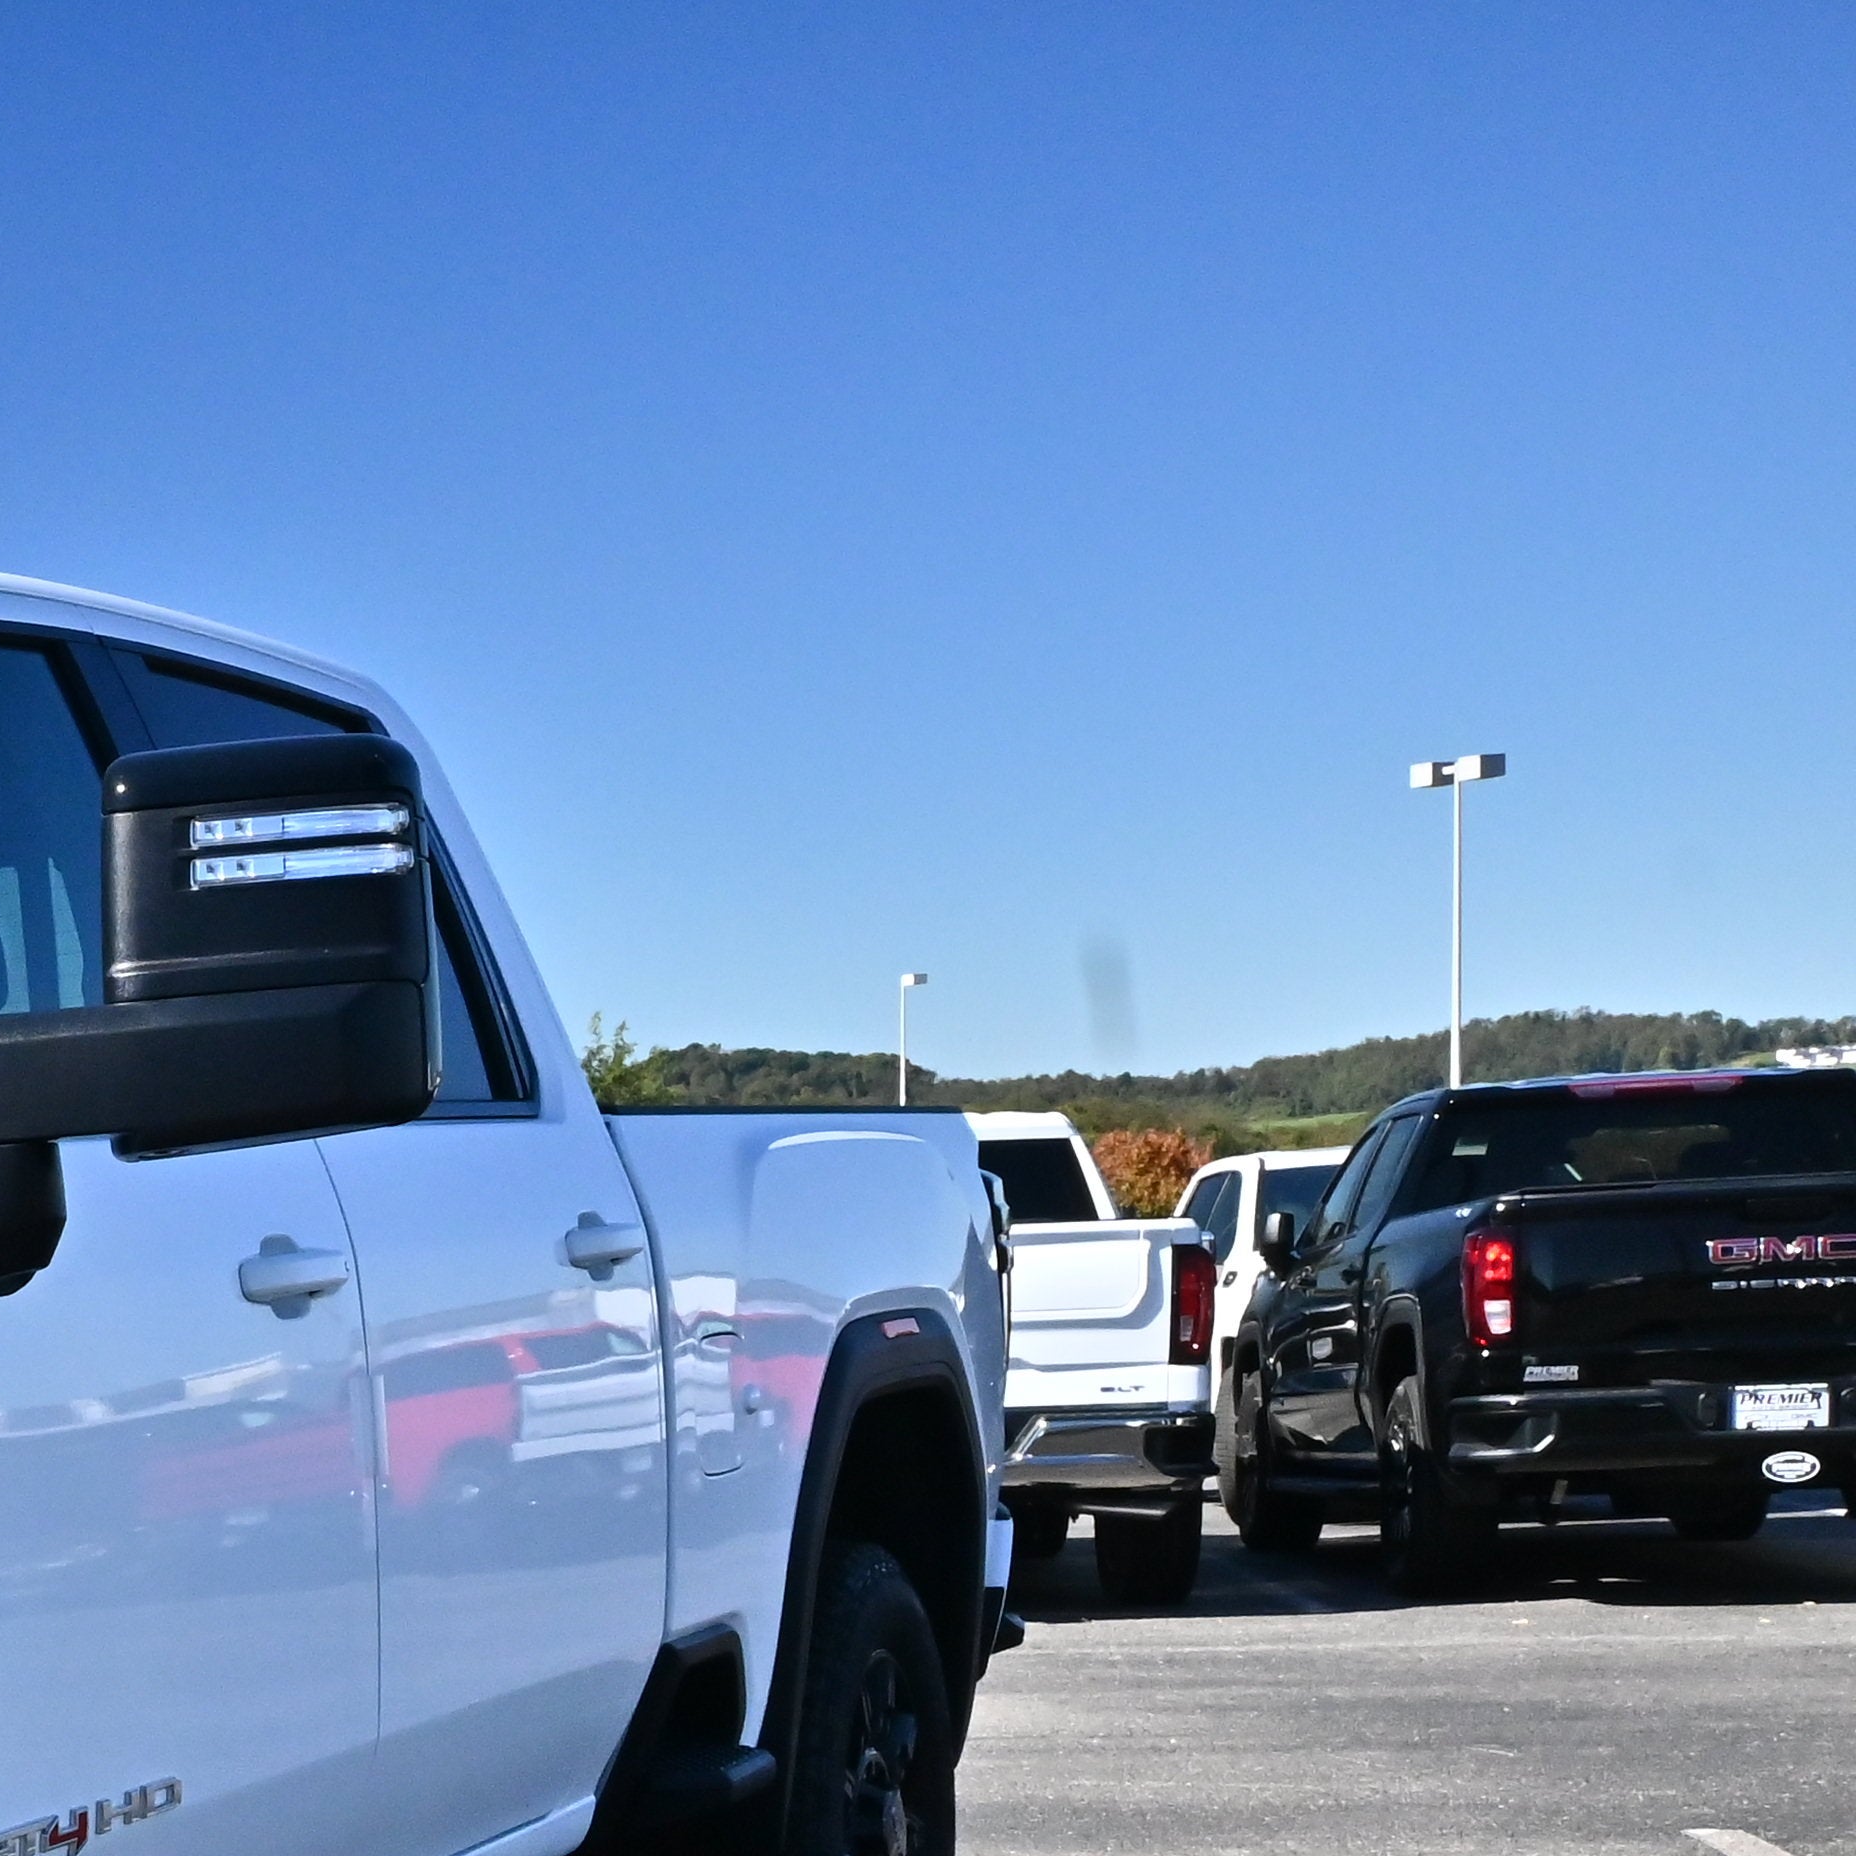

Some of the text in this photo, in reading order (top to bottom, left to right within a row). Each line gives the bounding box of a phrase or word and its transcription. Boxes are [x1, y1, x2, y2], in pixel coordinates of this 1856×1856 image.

[1706, 1233, 1856, 1265] GMC
[1740, 1390, 1823, 1405] PREMIER
[95, 1775, 183, 1836] HD
